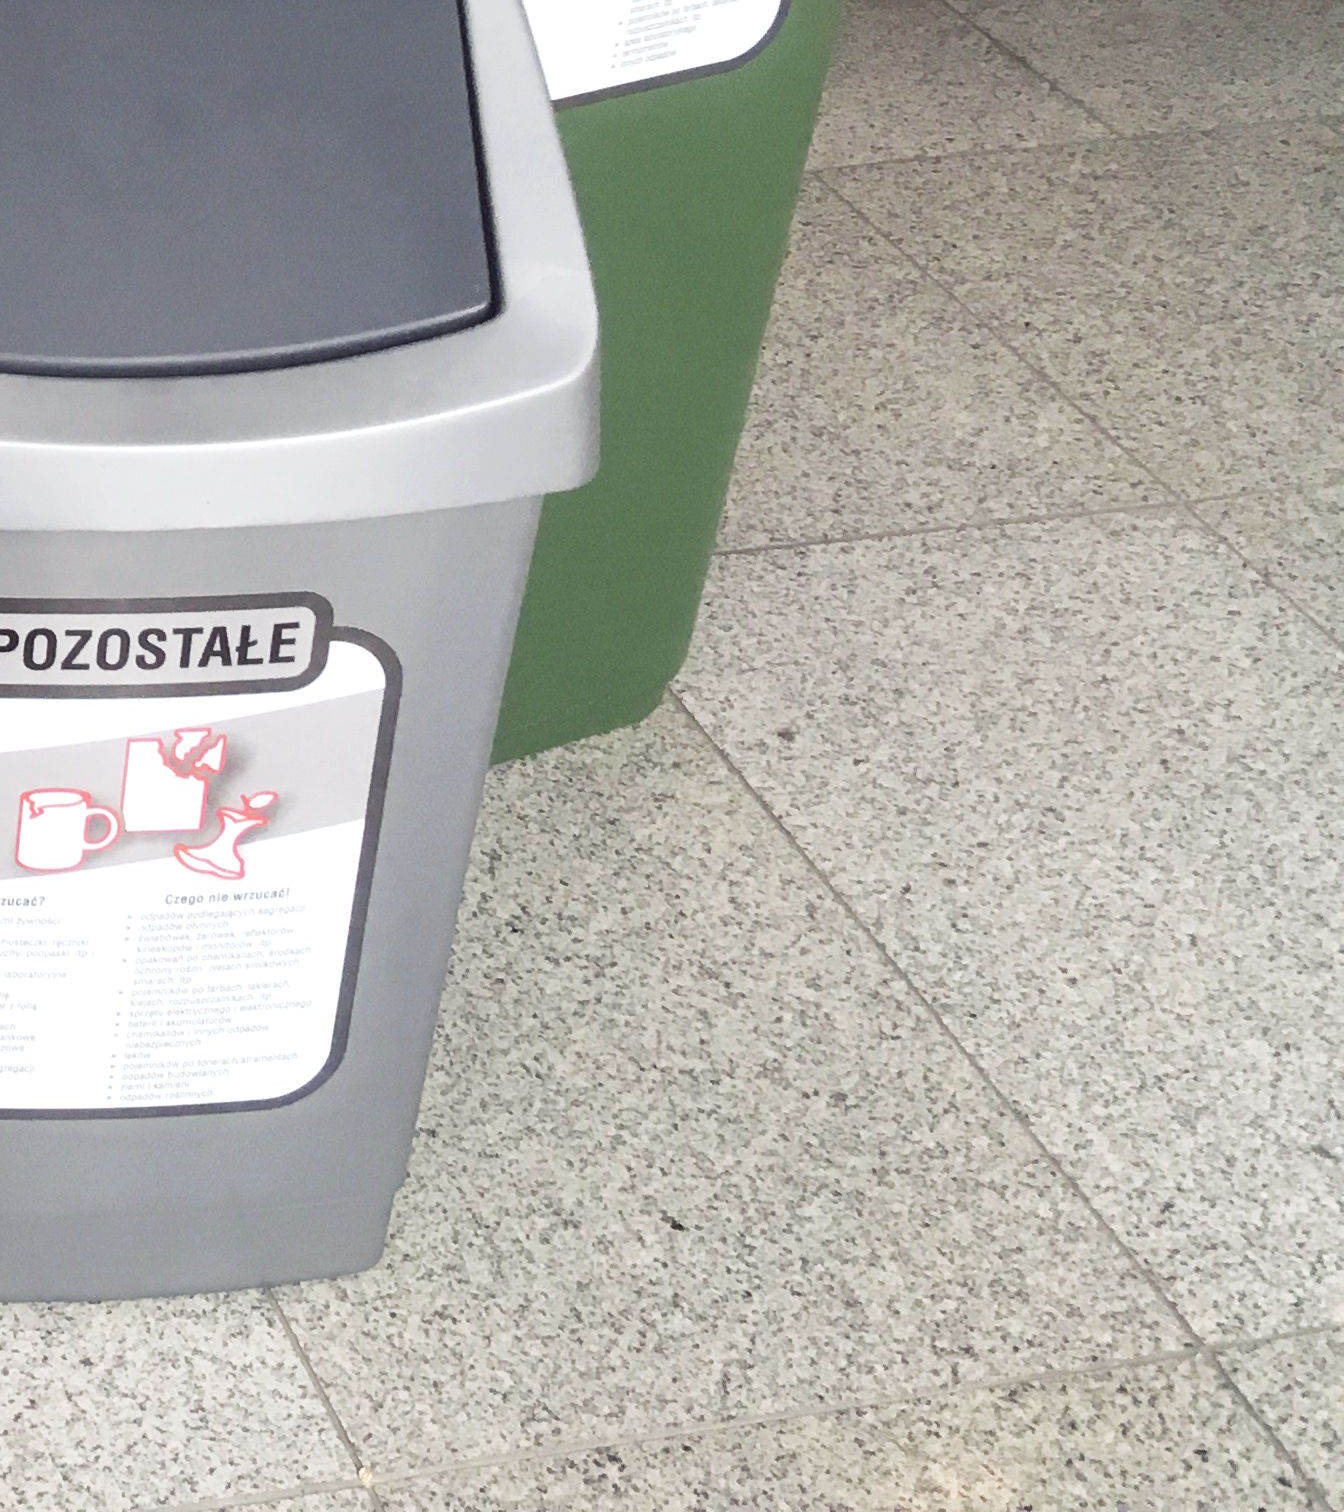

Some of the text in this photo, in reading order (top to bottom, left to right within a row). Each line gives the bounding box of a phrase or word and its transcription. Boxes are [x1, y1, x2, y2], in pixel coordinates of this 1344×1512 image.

[165, 888, 289, 906] Czego nie wrzucać!
